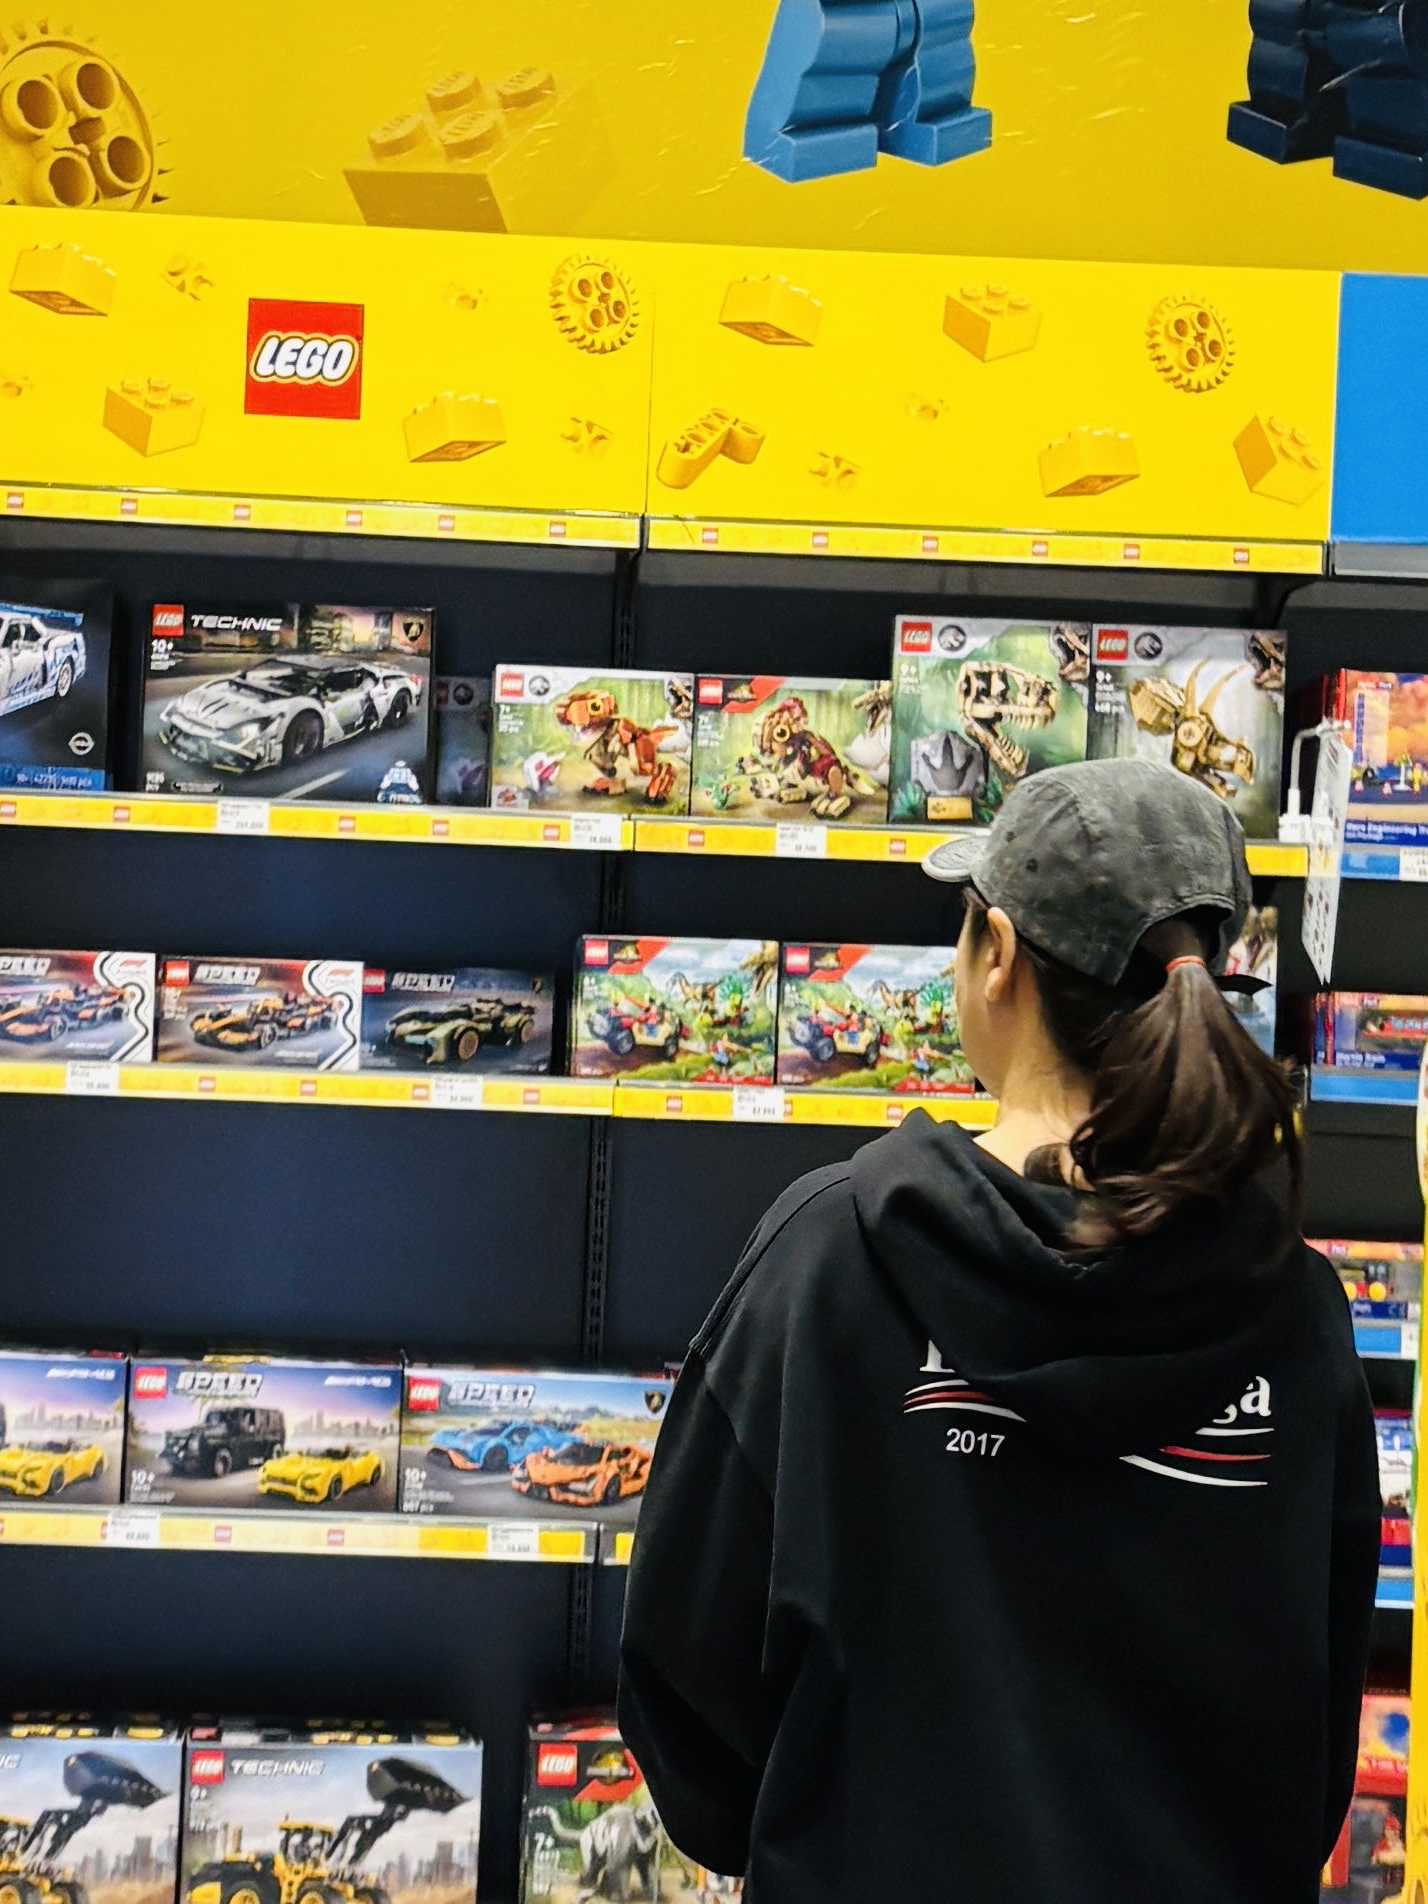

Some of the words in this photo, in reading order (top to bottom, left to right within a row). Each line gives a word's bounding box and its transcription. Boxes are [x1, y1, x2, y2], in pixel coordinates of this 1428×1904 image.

[255, 336, 354, 384] LEGO
[191, 614, 283, 632] TECHNIC
[946, 1427, 1006, 1457] 2017
[232, 1759, 325, 1776] TECHNIC
